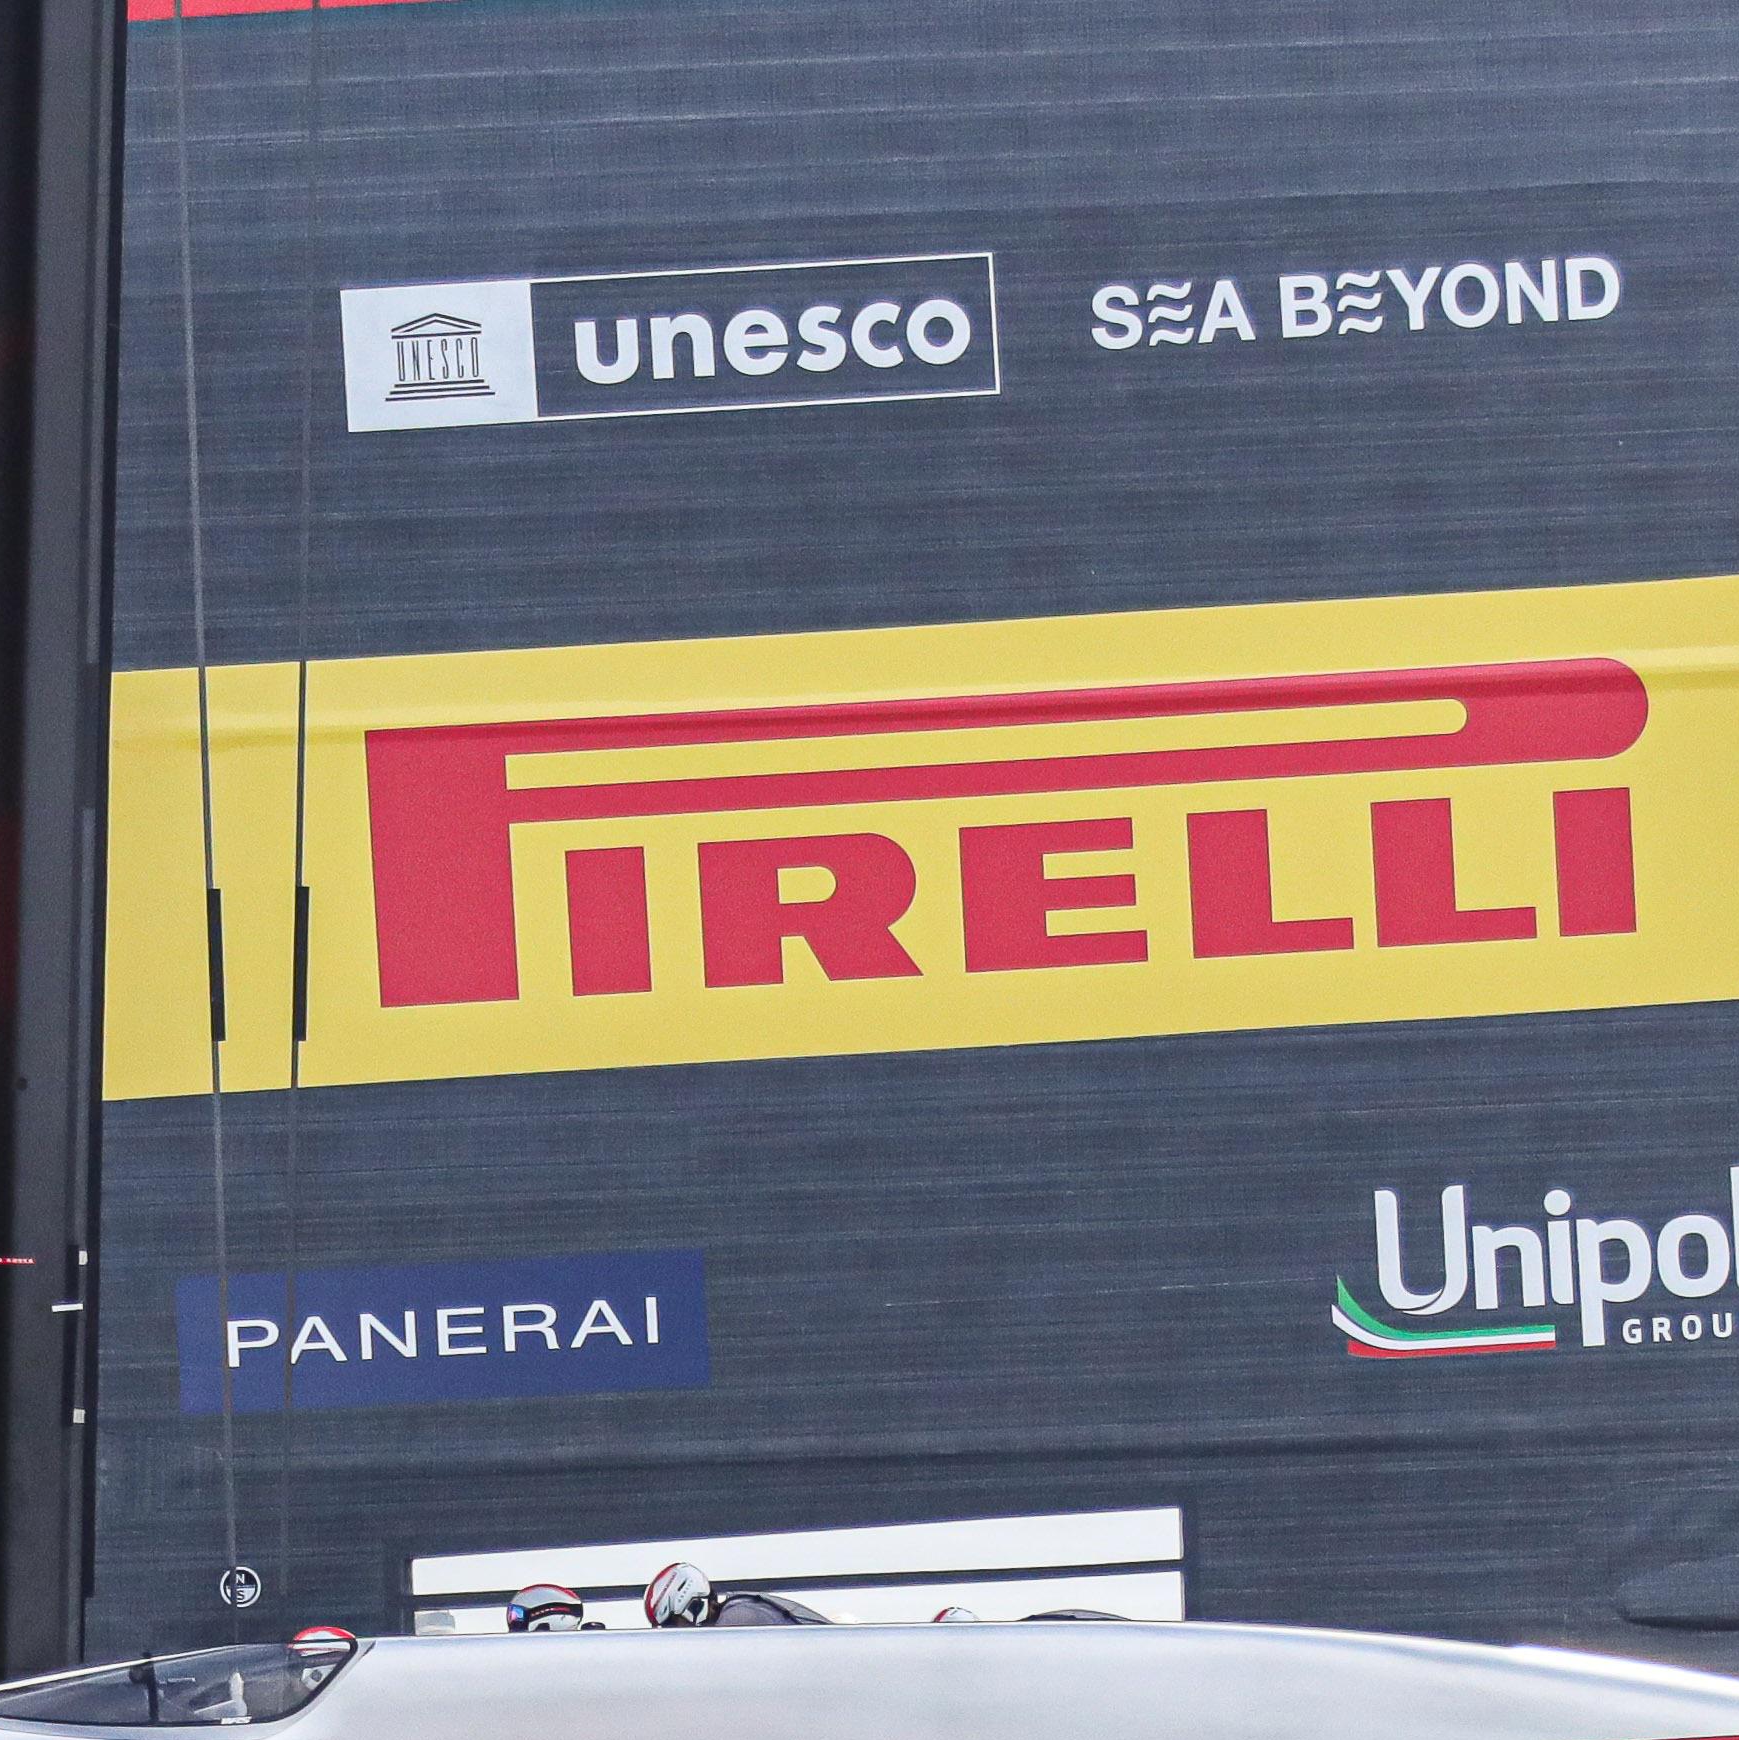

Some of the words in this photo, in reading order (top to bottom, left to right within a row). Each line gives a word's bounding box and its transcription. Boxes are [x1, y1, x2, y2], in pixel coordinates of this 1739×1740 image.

[573, 297, 973, 386] unesco
[1091, 279, 1257, 351] SEA
[1278, 255, 1622, 339] BEYOND
[396, 336, 480, 382] UNESCO
[365, 655, 1650, 1008] PIRELLI
[225, 1295, 660, 1368] PANERAI
